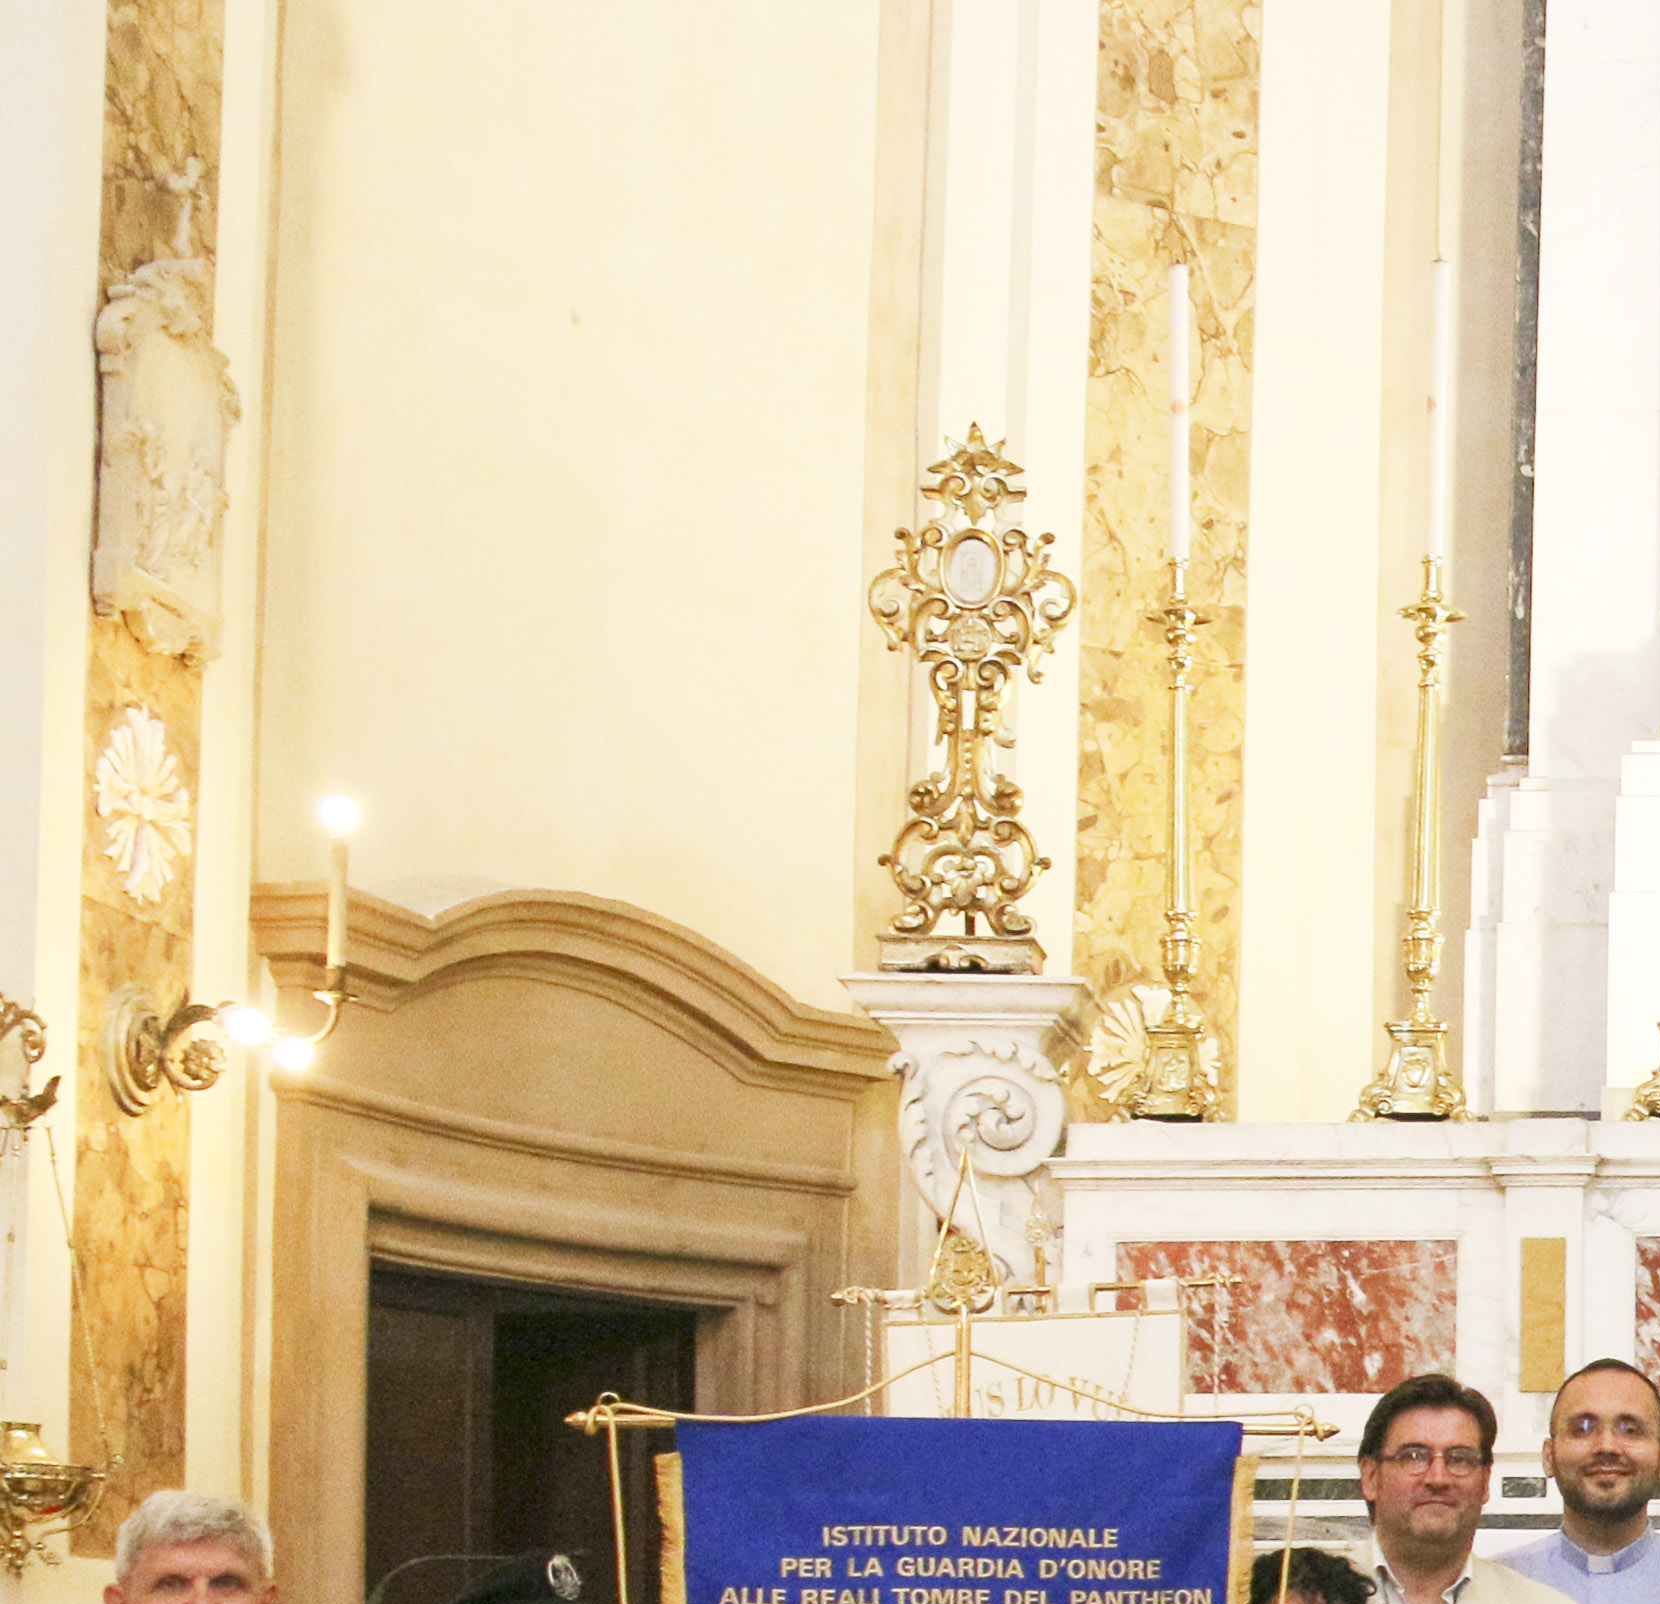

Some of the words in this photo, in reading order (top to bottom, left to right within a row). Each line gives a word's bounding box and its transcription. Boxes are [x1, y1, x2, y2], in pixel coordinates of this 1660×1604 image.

[822, 1525, 947, 1547] ISTITUTO
[961, 1526, 1119, 1548] NAZIONALE
[780, 1557, 832, 1578] PER
[847, 1557, 884, 1577] LA
[896, 1557, 1024, 1578] GUARDIA
[1039, 1558, 1160, 1580] D'ONORE
